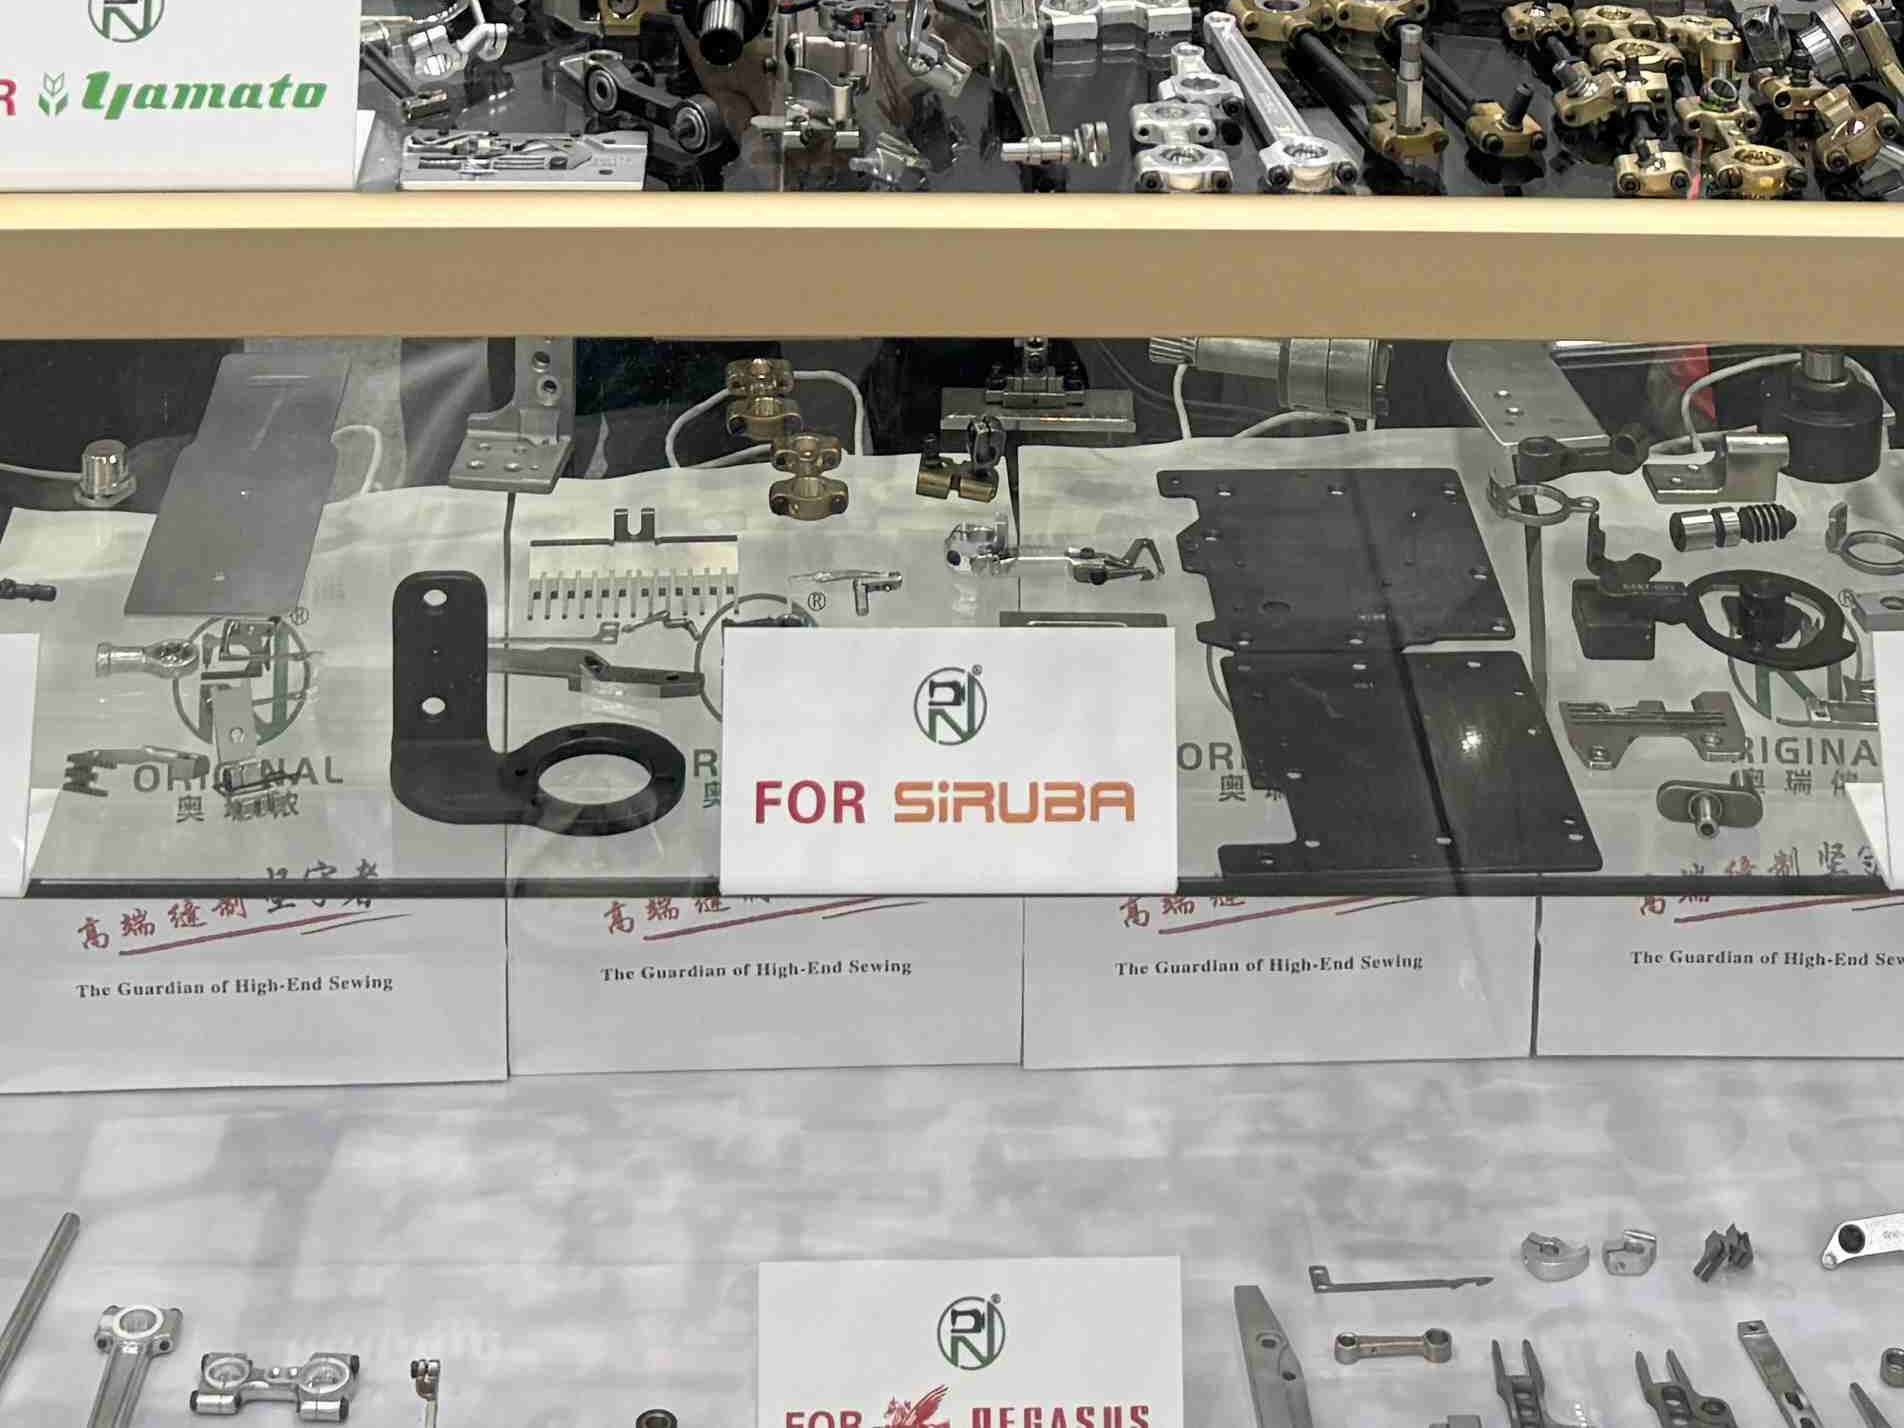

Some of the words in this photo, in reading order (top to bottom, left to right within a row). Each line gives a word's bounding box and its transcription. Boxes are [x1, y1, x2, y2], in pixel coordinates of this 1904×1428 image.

[754, 779, 866, 825] FOR
[600, 967, 635, 982] The
[641, 965, 726, 980] Guardian
[733, 963, 751, 978] of
[757, 961, 842, 979] High-End
[849, 959, 912, 975] Sewing
[1114, 961, 1148, 977] The
[1155, 959, 1239, 975] Guardian
[1246, 958, 1264, 973] of
[1269, 956, 1354, 975] High-End
[1360, 954, 1424, 971] Sewing
[1630, 951, 1663, 966] The
[1669, 950, 1753, 966] Guardian
[1760, 950, 1778, 966] of
[1784, 951, 1869, 969] High-End
[76, 984, 111, 998] The
[117, 981, 204, 997] Guardian
[211, 980, 229, 995] of
[235, 977, 323, 995] High-End
[329, 975, 394, 992] Sewing
